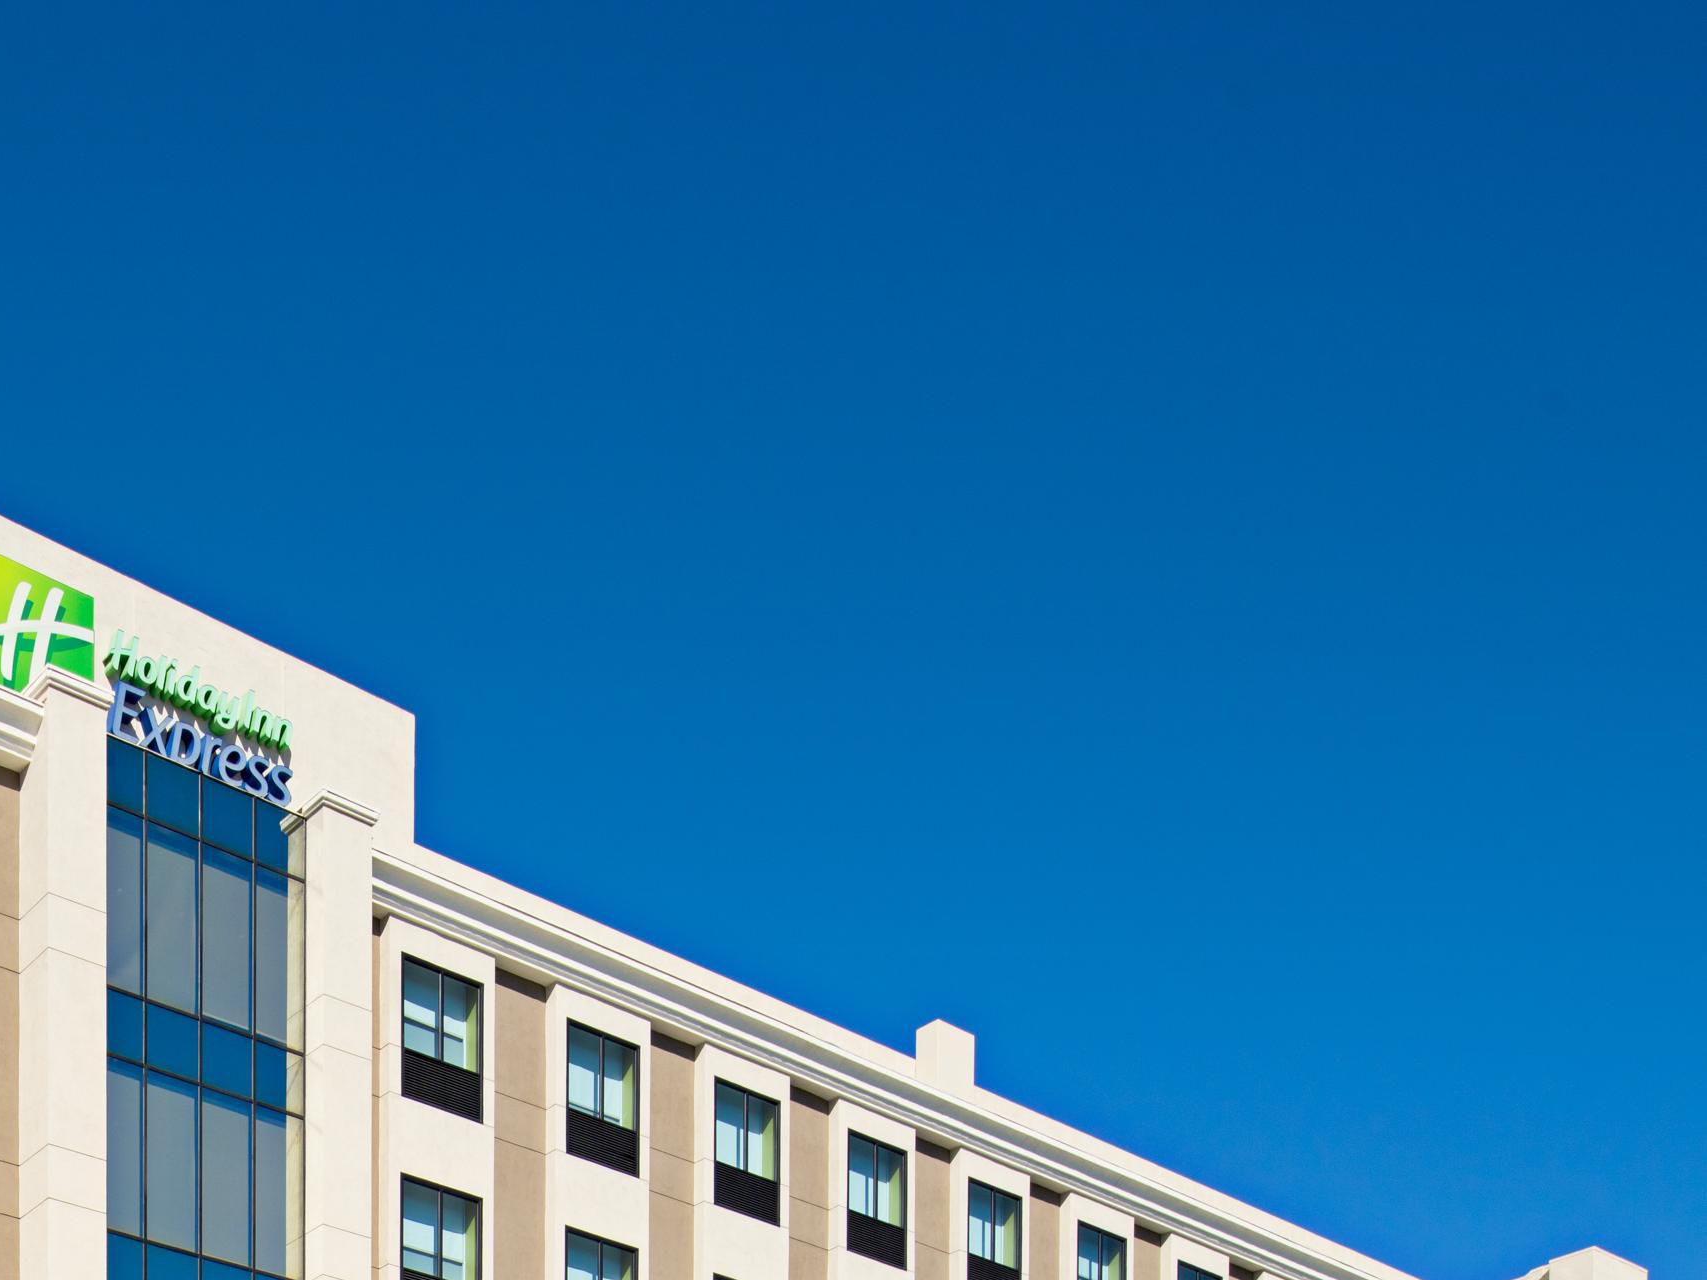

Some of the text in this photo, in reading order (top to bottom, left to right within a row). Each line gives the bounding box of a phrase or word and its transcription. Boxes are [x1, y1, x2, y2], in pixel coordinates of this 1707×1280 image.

[106, 629, 293, 751] Holiday Inn
[107, 680, 293, 806] Express
